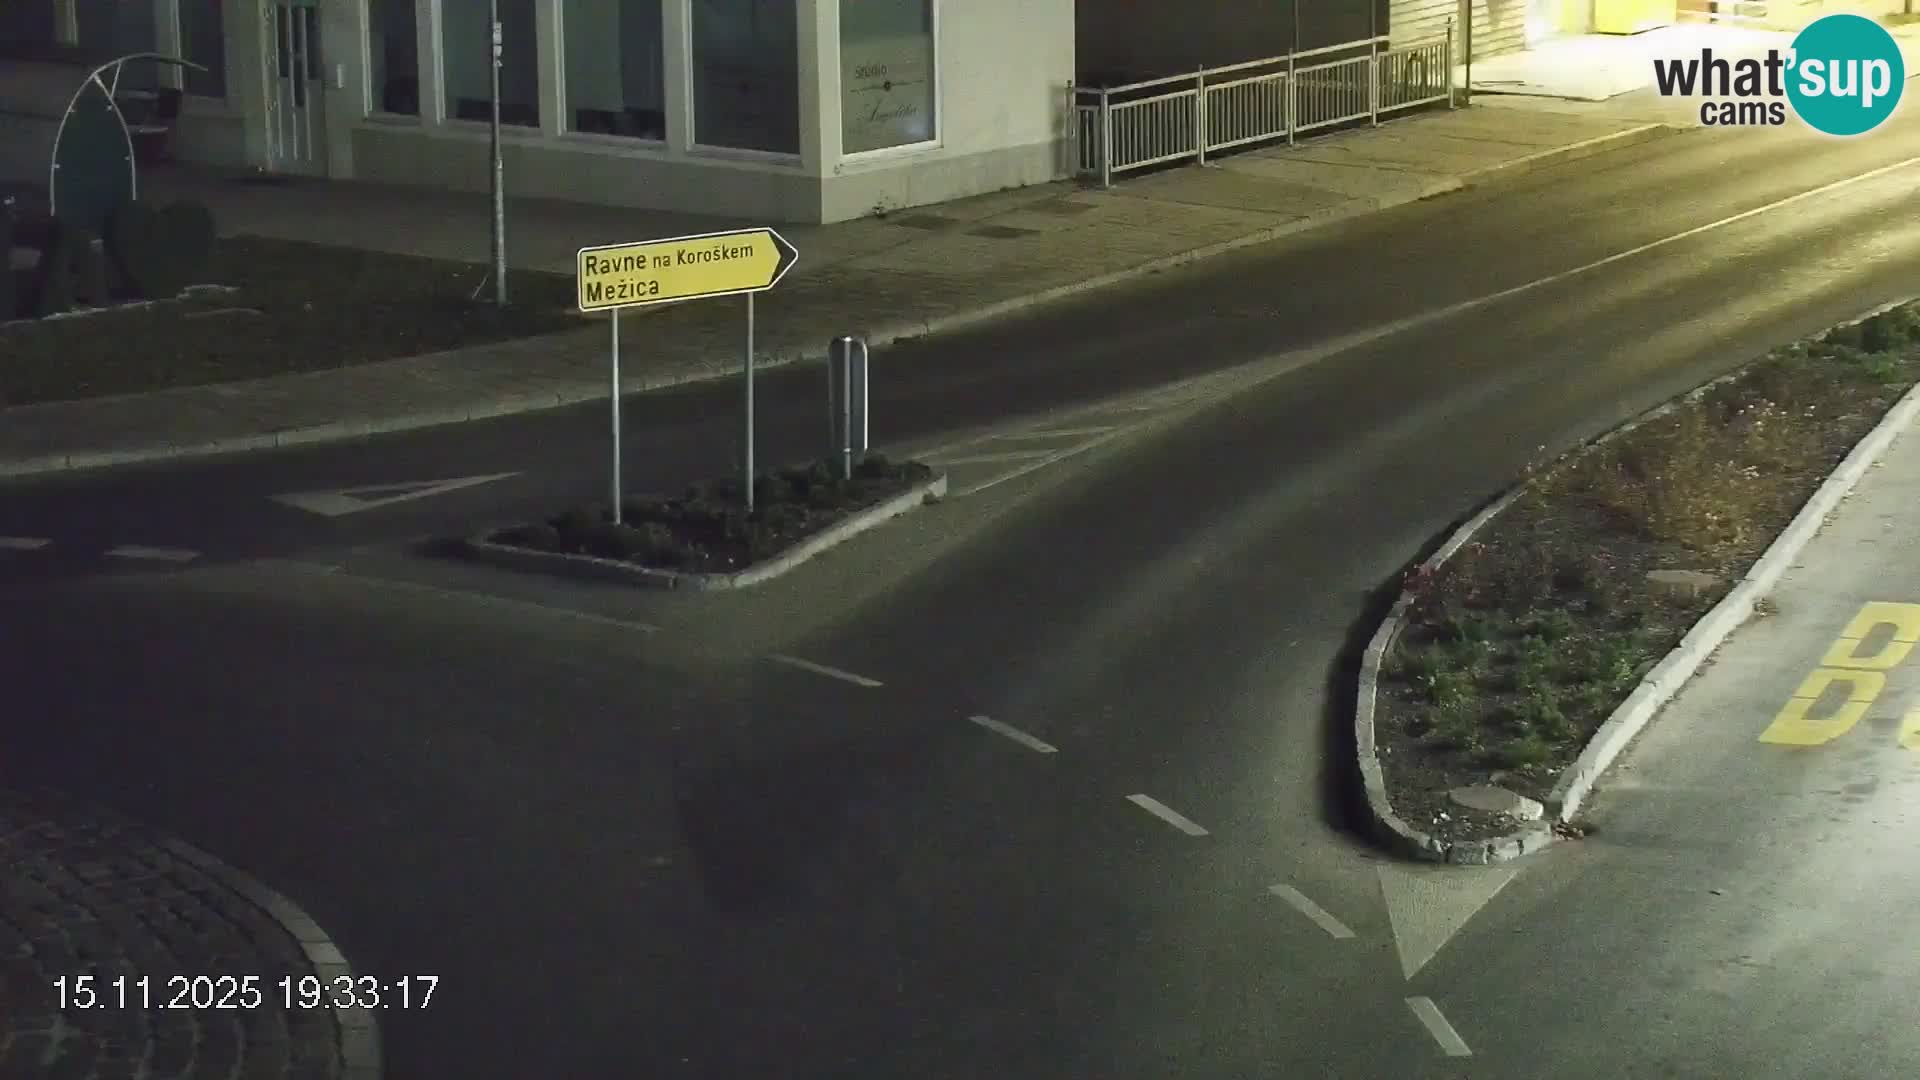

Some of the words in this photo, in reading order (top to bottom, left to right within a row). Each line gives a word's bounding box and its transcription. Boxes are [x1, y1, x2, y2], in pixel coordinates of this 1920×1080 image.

[585, 254, 647, 277] Ravne
[653, 254, 671, 269] na
[677, 244, 754, 266] Koroškem
[586, 279, 660, 303] Mežica
